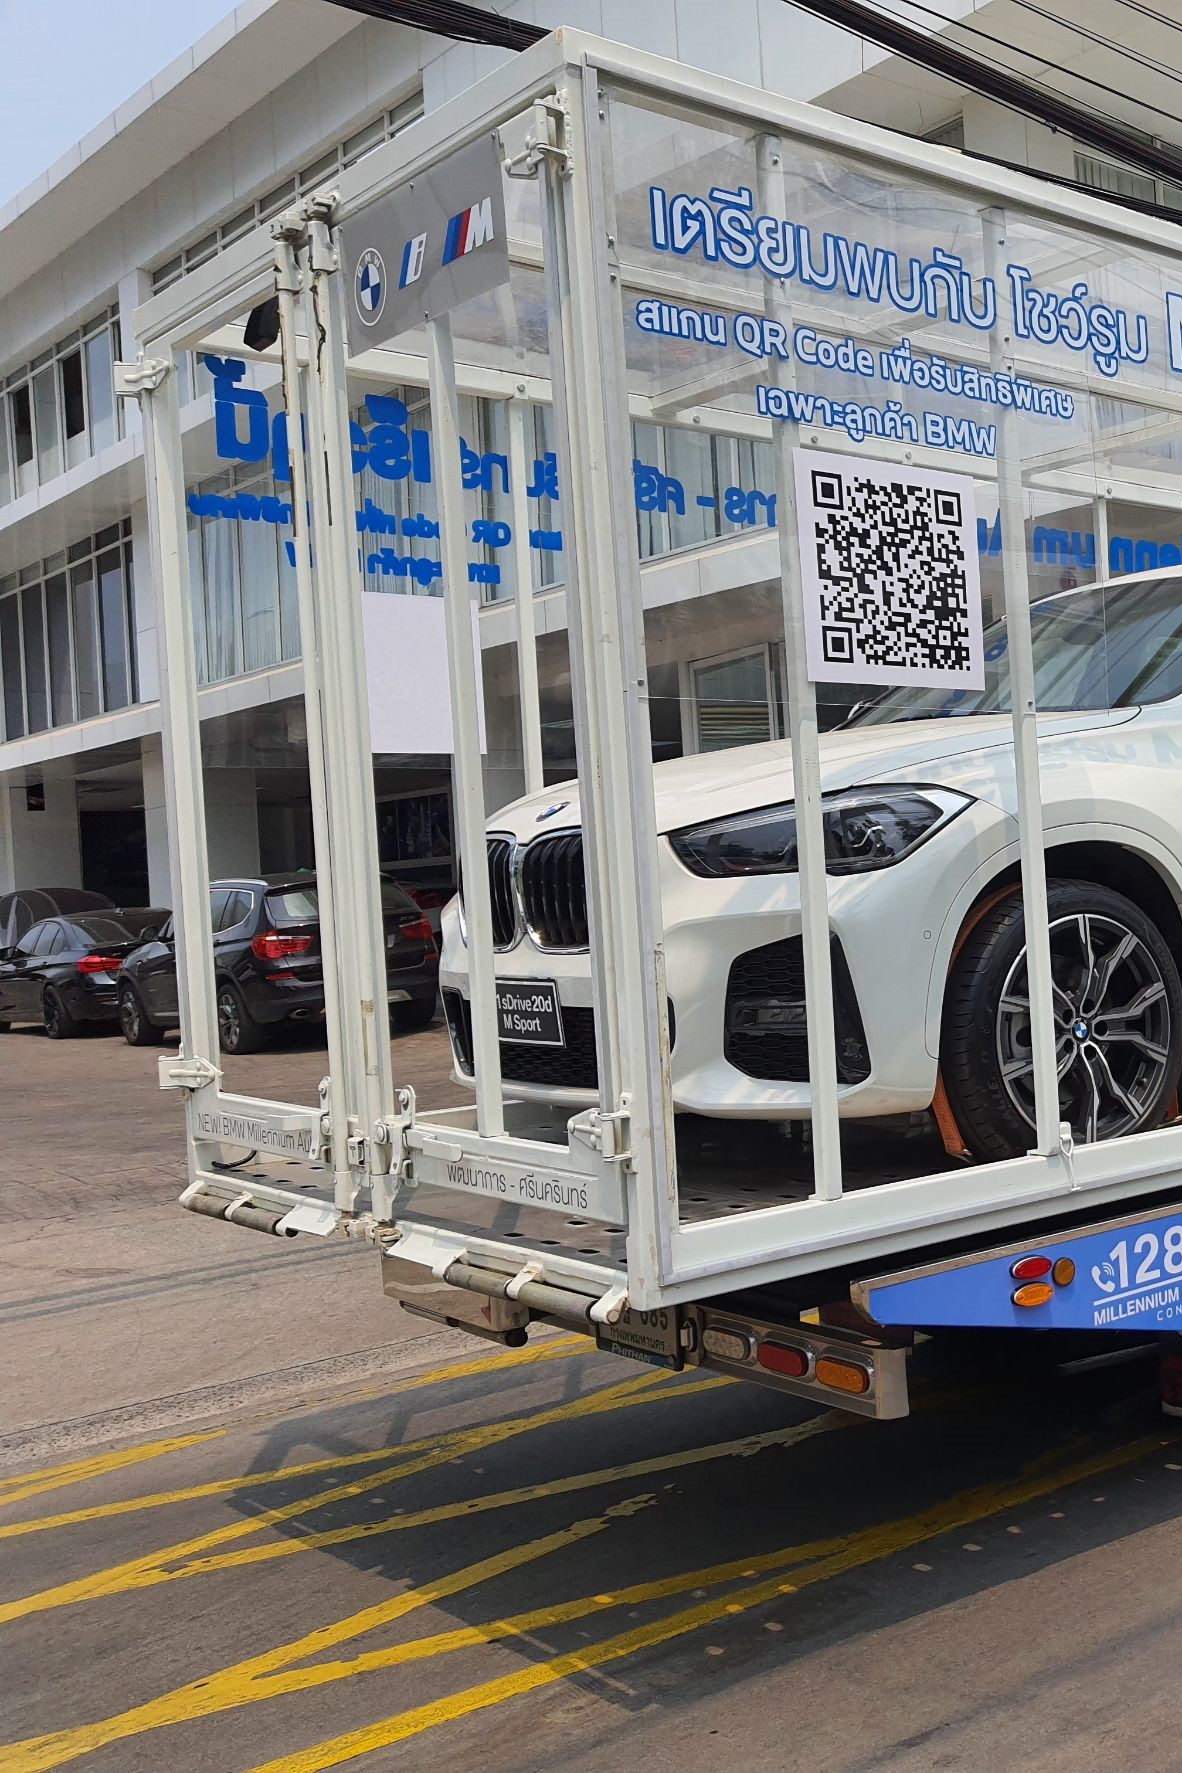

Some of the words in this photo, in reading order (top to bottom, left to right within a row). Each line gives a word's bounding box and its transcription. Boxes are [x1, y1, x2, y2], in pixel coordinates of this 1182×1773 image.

[649, 185, 996, 331] เตรียมพบกับ
[1007, 264, 1149, 377] โชว์รูม
[635, 299, 727, 348] สแกน
[734, 312, 789, 359] QR
[794, 325, 875, 378] Code
[880, 339, 1075, 419] เพื่อรับสิทธิพิเศษ
[756, 384, 918, 444] เฉพาะลูกค้า
[923, 410, 997, 457] BMW
[502, 993, 553, 1012] sDrive20d
[503, 1013, 513, 1029] M
[513, 1014, 542, 1034] Sport
[198, 1112, 222, 1134] NEW!
[223, 1117, 246, 1140] BMW
[247, 1121, 295, 1149] Millennium
[1094, 1285, 1180, 1326] MILLENNIUM
